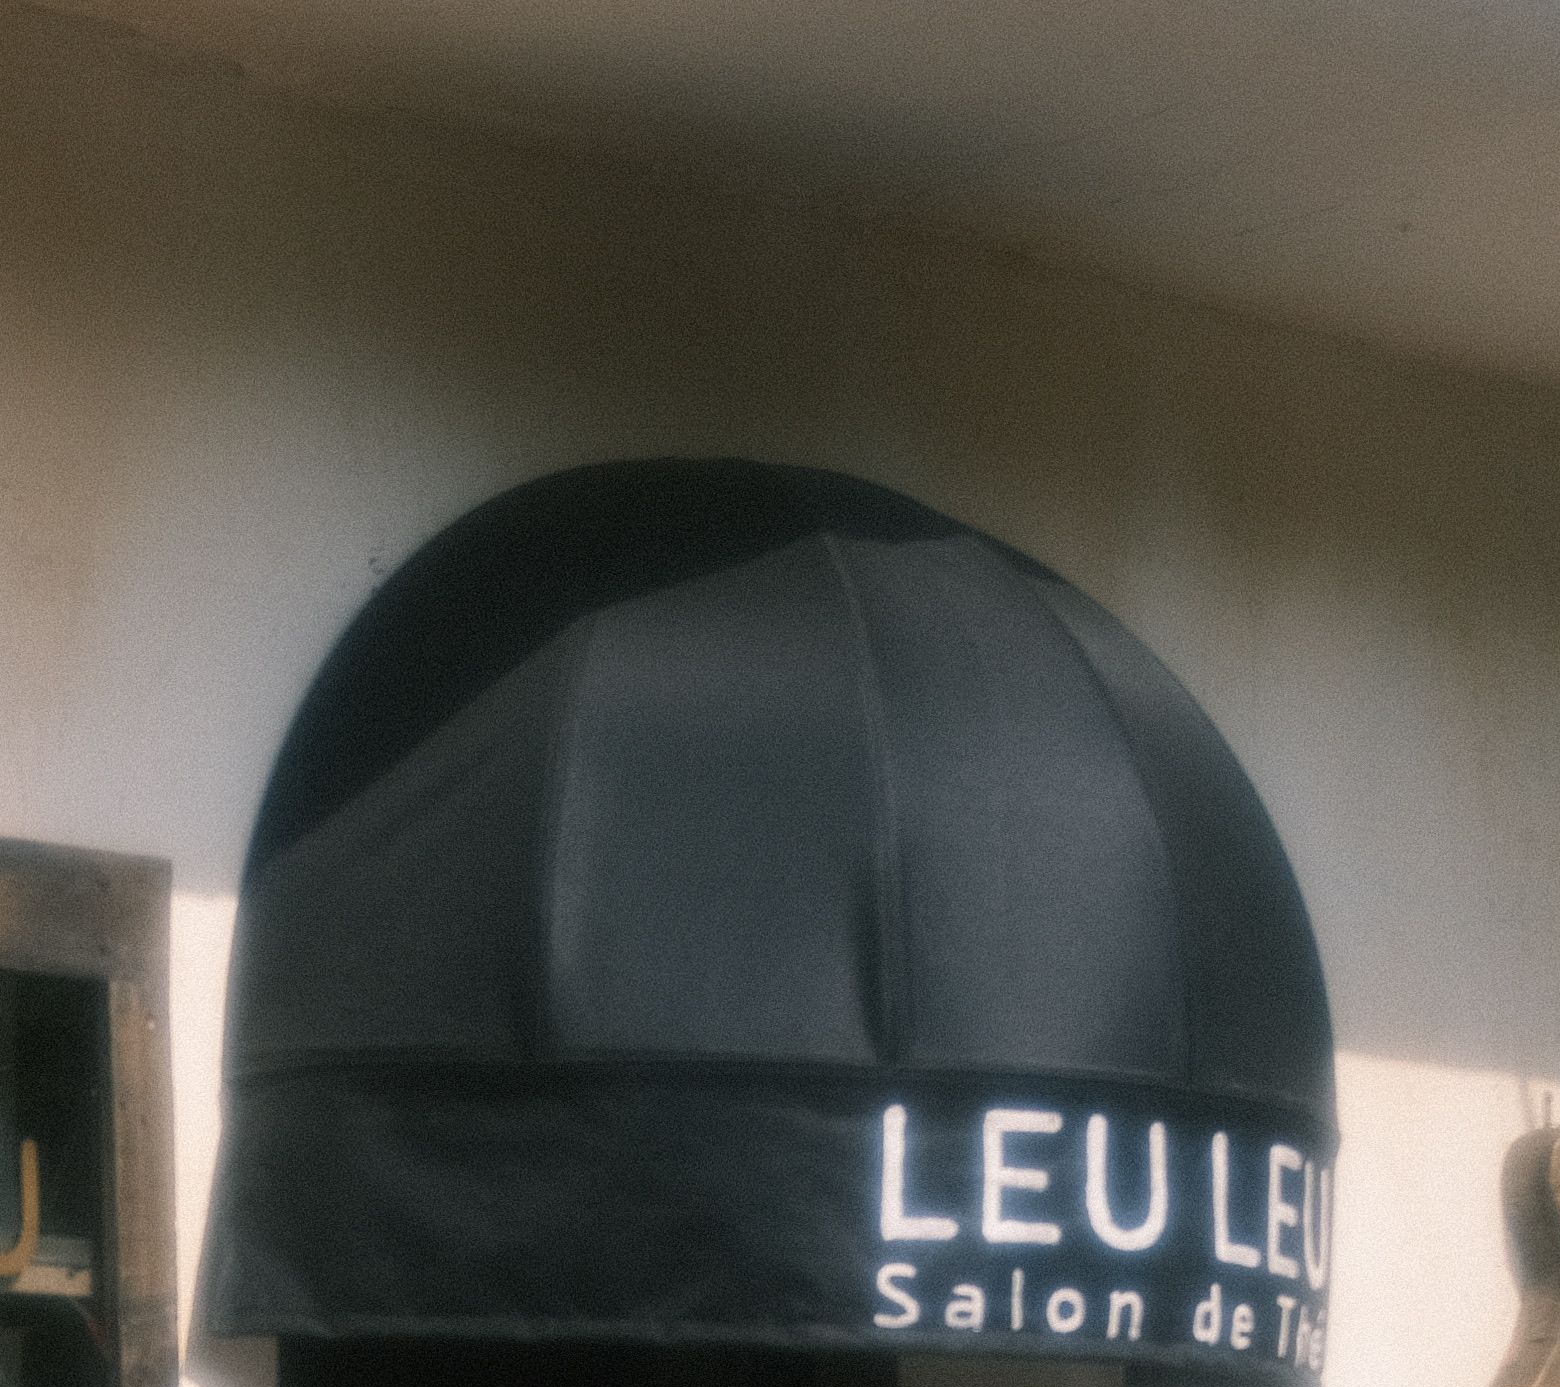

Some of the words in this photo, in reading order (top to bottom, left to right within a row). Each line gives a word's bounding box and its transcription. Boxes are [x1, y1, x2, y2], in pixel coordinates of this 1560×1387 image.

[881, 1104, 1168, 1252] LEU
[1211, 1131, 1329, 1291] LEU
[873, 1262, 1145, 1341] Salon
[1193, 1283, 1255, 1351] de
